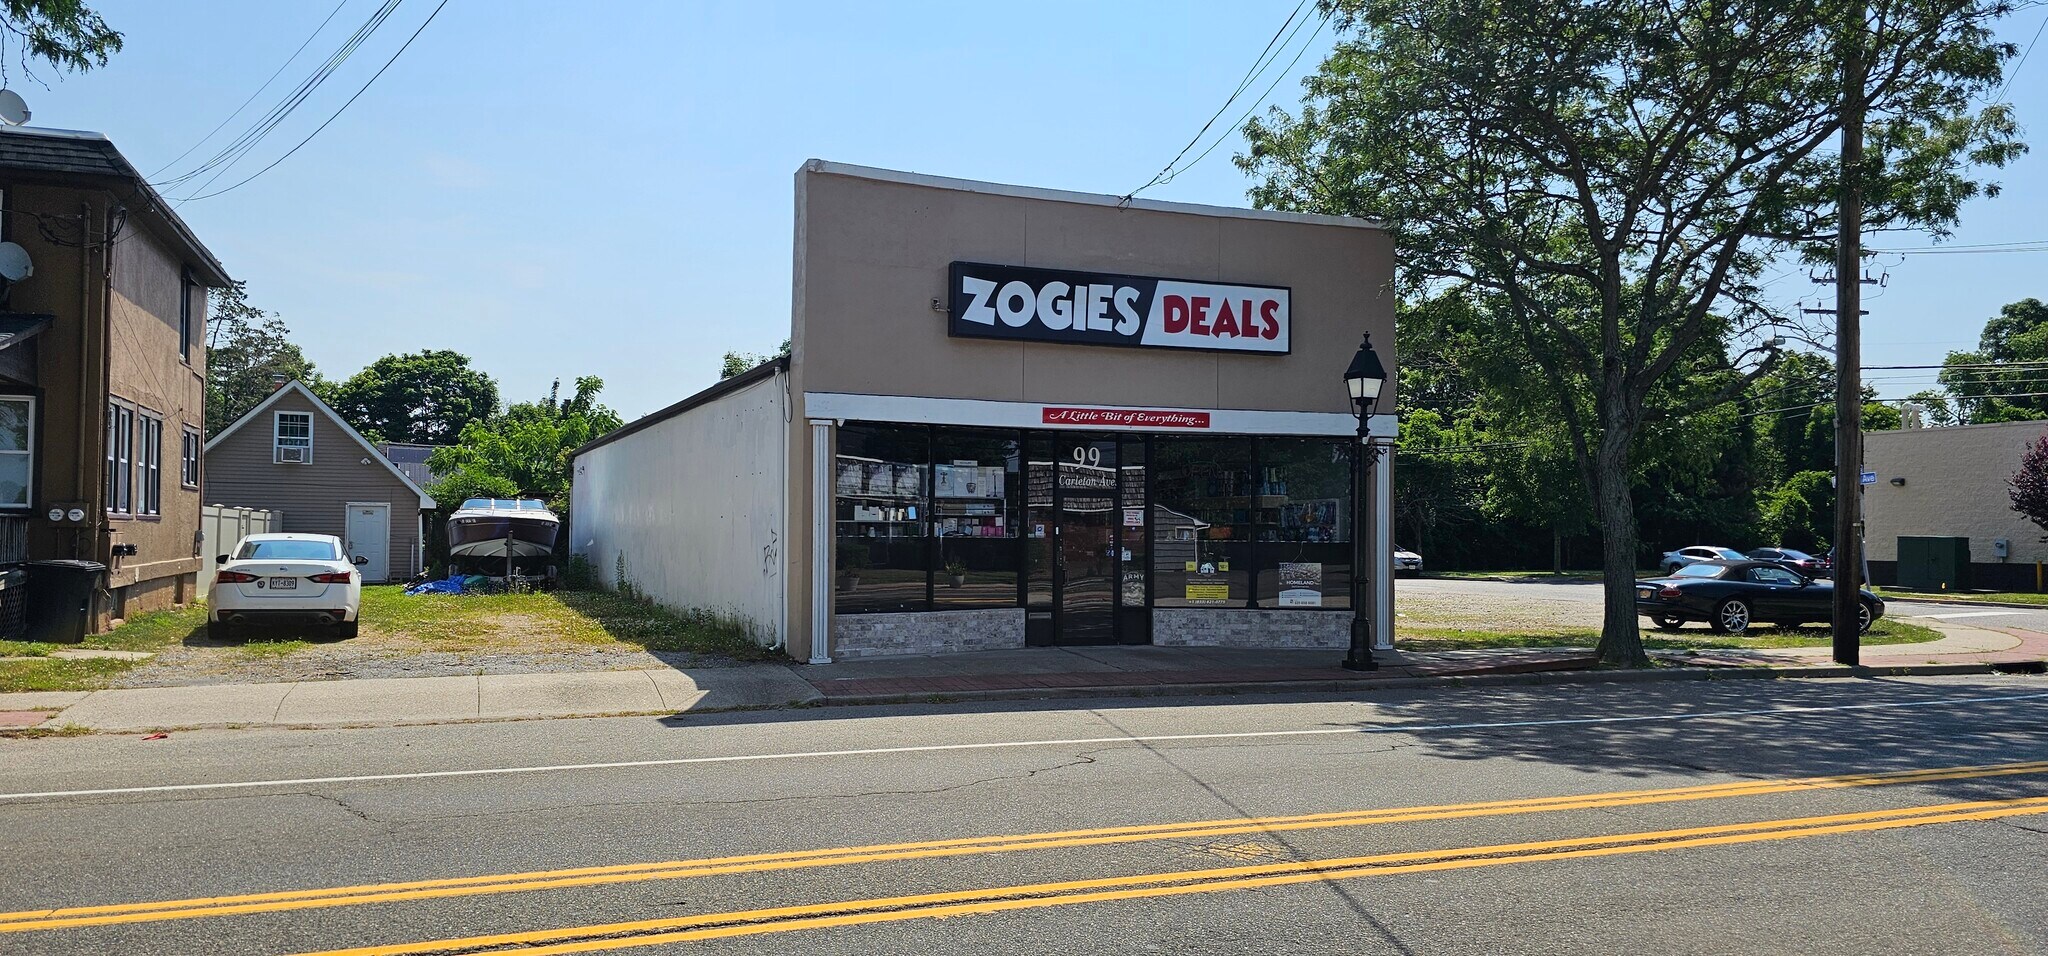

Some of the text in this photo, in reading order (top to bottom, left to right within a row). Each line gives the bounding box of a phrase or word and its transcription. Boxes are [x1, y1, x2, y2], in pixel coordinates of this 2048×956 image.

[962, 276, 1279, 340] ZOGIES DEALS
[1050, 411, 1205, 426] A Little Bit of Everything...
[1073, 446, 1100, 469] 99
[1059, 474, 1117, 487] Carleton Ave.
[1862, 474, 1875, 483] Ave
[1123, 573, 1144, 581] ARMY
